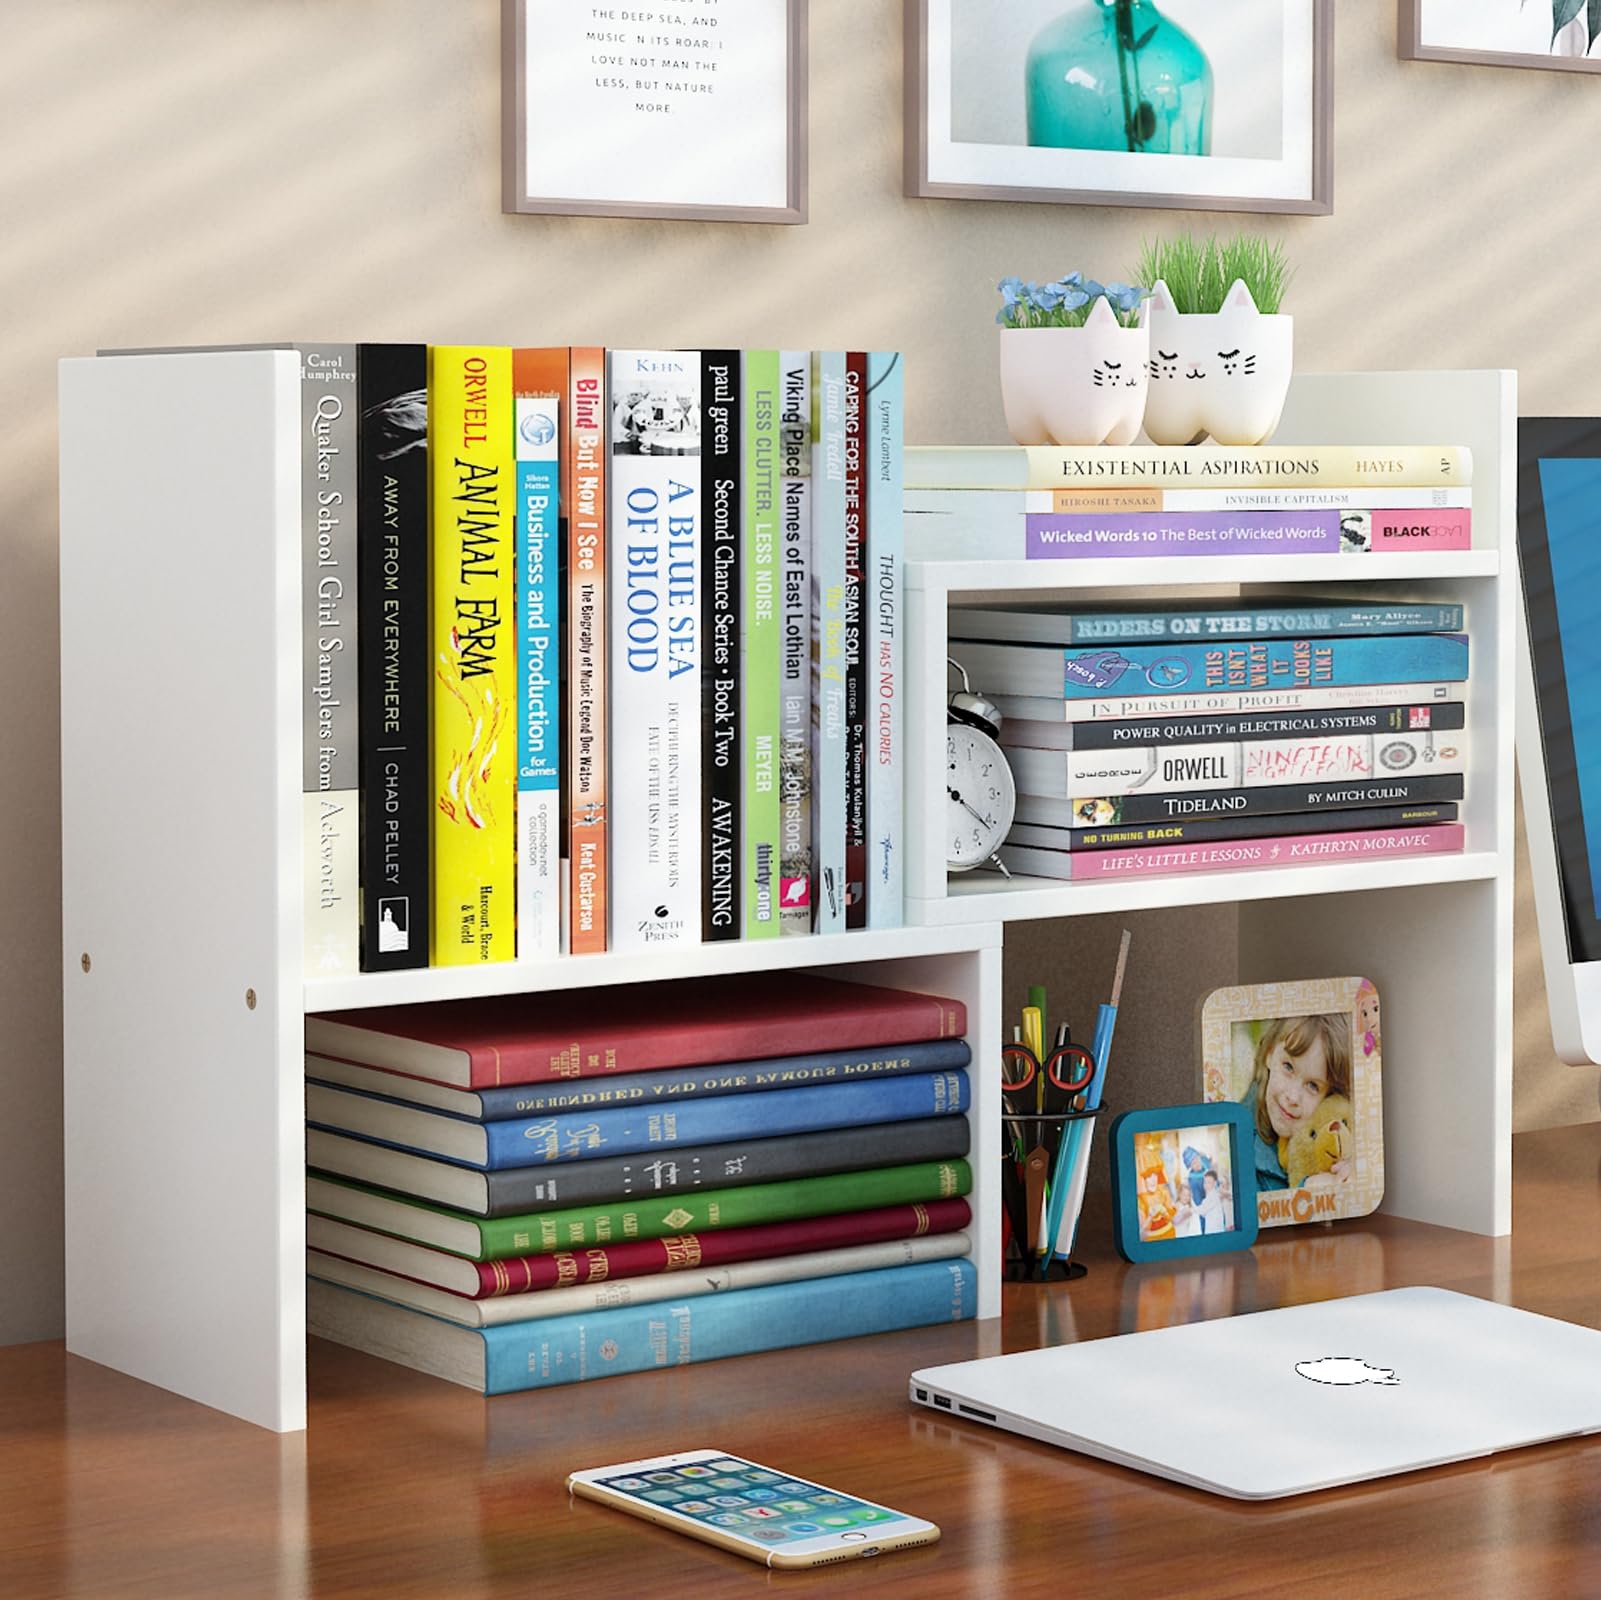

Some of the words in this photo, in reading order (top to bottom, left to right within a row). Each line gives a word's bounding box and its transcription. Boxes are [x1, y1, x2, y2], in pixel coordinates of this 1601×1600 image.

[586, 32, 626, 43] MUSIC
[592, 9, 615, 20] THE
[621, 11, 653, 21] DEEP
[692, 17, 718, 27] AND
[592, 55, 625, 66] LOVE
[631, 57, 656, 67] NOT
[662, 60, 689, 69] MAN
[696, 61, 717, 71] THE
[636, 79, 659, 90] BUT
[666, 82, 714, 94] NATURE
[307, 353, 342, 368] Carol
[464, 357, 488, 449] ORWELL
[575, 378, 600, 430] Blind
[708, 365, 734, 402] paul
[782, 368, 805, 423] Viking
[823, 373, 845, 424] Jamie
[709, 406, 728, 455] green
[755, 389, 773, 431] LESS
[879, 399, 892, 434] Lynne
[311, 395, 343, 482] Quaker
[577, 435, 600, 471] But
[786, 429, 805, 477] Place
[846, 439, 860, 472] FOR
[880, 436, 892, 481] Lambert
[755, 437, 773, 517] CLUTTER.
[1063, 460, 1192, 476] EXISTENTIAL
[1199, 458, 1319, 476] ASPIRATIONS
[1356, 460, 1404, 474] HAYES
[384, 475, 399, 528] AWAY
[577, 476, 600, 515] Now
[626, 488, 660, 535] OF
[668, 479, 695, 503] A
[714, 479, 736, 540] Second
[786, 482, 805, 542] Names
[846, 477, 860, 509] THE
[1060, 498, 1111, 508] HIROSHI
[1113, 497, 1157, 507] TASAKA
[1225, 495, 1282, 505] INVISIBLE
[1284, 494, 1349, 505] CAPITALISM
[317, 491, 344, 566] School
[451, 457, 501, 586] ANIMAL
[527, 495, 550, 585] Business
[846, 512, 860, 568] SOUTH
[1039, 528, 1092, 544] Wicked
[1094, 528, 1140, 543] Words
[1160, 528, 1185, 541] The
[1187, 528, 1217, 541] Best
[1219, 527, 1236, 541] of
[1236, 527, 1285, 541] Wicked
[1287, 525, 1327, 539] Words
[1383, 525, 1430, 537] BLACK
[384, 534, 399, 590] FROM
[577, 534, 599, 571] See
[668, 516, 695, 608] BLUE
[755, 523, 773, 565] LESS
[786, 546, 805, 566] of
[581, 584, 595, 602] The
[714, 546, 736, 610] Chance
[755, 570, 773, 627] NOISE.
[786, 570, 805, 609] East
[846, 574, 860, 623] ASIAN
[879, 553, 895, 637] THOUGHT
[317, 576, 343, 628] Girl
[527, 592, 550, 629] and
[626, 544, 660, 674] BLOOD
[1351, 612, 1381, 621] Mary
[452, 597, 502, 682] FARM
[577, 604, 595, 655] Biography
[714, 613, 735, 665] Series
[1077, 618, 1166, 638] RIDERS
[1170, 617, 1201, 634] ON
[1206, 615, 1252, 633] THE
[1255, 613, 1333, 633] STORM
[384, 599, 400, 733] EVERYWHERE
[580, 657, 595, 668] of
[668, 616, 696, 680] SEA
[786, 614, 805, 680] Lothian
[879, 641, 892, 668] HAS
[1249, 643, 1269, 688] WHAT
[1272, 659, 1290, 676] IT
[1293, 640, 1312, 687] LOOKS
[1315, 647, 1333, 682] LIKE
[313, 638, 344, 740] Samplers
[580, 670, 595, 698] Music
[879, 671, 895, 698] NO
[1205, 650, 1225, 688] THIS
[527, 636, 552, 753] Production
[714, 679, 735, 722] Book
[785, 695, 805, 723] Iain
[848, 677, 857, 719] EDITORS:
[1091, 702, 1111, 718] IN
[1121, 698, 1199, 717] PURSUIT
[1207, 696, 1229, 709] OF
[1239, 694, 1303, 712] PROFIT
[576, 699, 594, 734] Legend
[853, 723, 863, 742] Dr.
[879, 702, 892, 765] CALORIES
[1113, 726, 1161, 741] POWER
[1164, 723, 1223, 739] QUALITY
[1239, 718, 1319, 734] ELECTRICAL
[1321, 715, 1377, 729] SYSTEMS
[530, 755, 547, 767] for
[580, 736, 594, 755] Doc
[714, 726, 735, 768] Two
[755, 735, 773, 792] MEYER
[853, 743, 863, 785] Thomas
[318, 745, 340, 791] from
[385, 761, 399, 813] CHAD
[520, 766, 557, 777] Games
[580, 757, 594, 793] Watson
[981, 765, 990, 777] 2
[1163, 755, 1229, 783] ORWELL
[785, 772, 805, 853] Johnstone
[988, 787, 996, 800] 3
[1163, 795, 1247, 816] TIDELAND
[1308, 793, 1323, 804] BY
[1325, 789, 1365, 803] MITCH
[1367, 787, 1409, 801] CULLIN
[528, 816, 541, 867] collection
[953, 836, 962, 849] 6
[972, 829, 980, 842] 5
[1083, 834, 1098, 844] NO
[1101, 830, 1145, 843] TURNING
[1147, 827, 1184, 841] BACK
[1402, 810, 1438, 820] BARBOUR
[319, 801, 345, 910] Ackworth
[385, 820, 399, 884] PELLEY
[579, 842, 598, 869] Kent
[712, 797, 733, 927] AWAKENING
[1102, 853, 1145, 871] LIFE'S
[1147, 850, 1198, 868] LITTLE
[1201, 847, 1262, 865] LESSONS
[1290, 840, 1361, 857] KATHRYN
[1362, 833, 1432, 851] MORAVEC
[477, 886, 493, 932] Harcourt,
[579, 871, 598, 932] Gustavson
[461, 914, 475, 944] World
[479, 932, 493, 961] Brace
